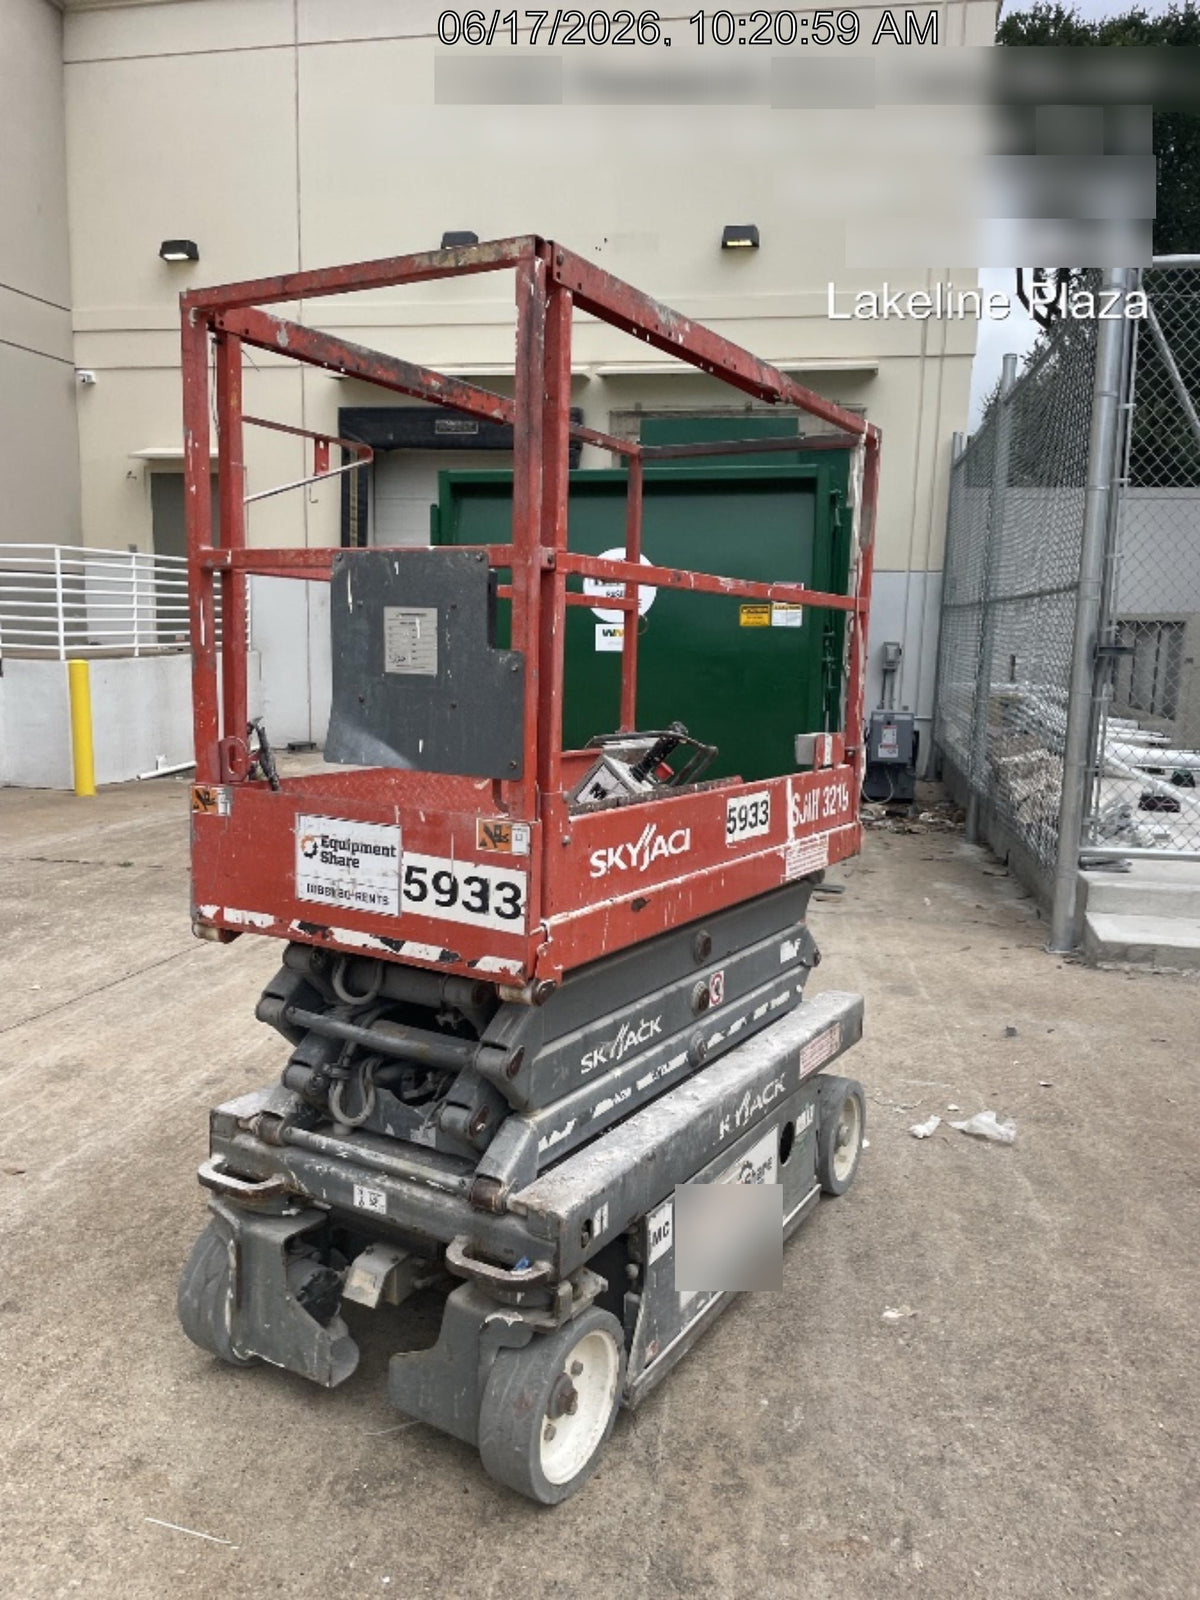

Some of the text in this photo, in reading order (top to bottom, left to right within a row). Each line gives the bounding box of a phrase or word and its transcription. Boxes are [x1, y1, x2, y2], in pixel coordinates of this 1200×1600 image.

[727, 798, 770, 835] 5933
[320, 834, 397, 858] Equipment
[320, 851, 360, 869] Share
[403, 864, 522, 920] 5933
